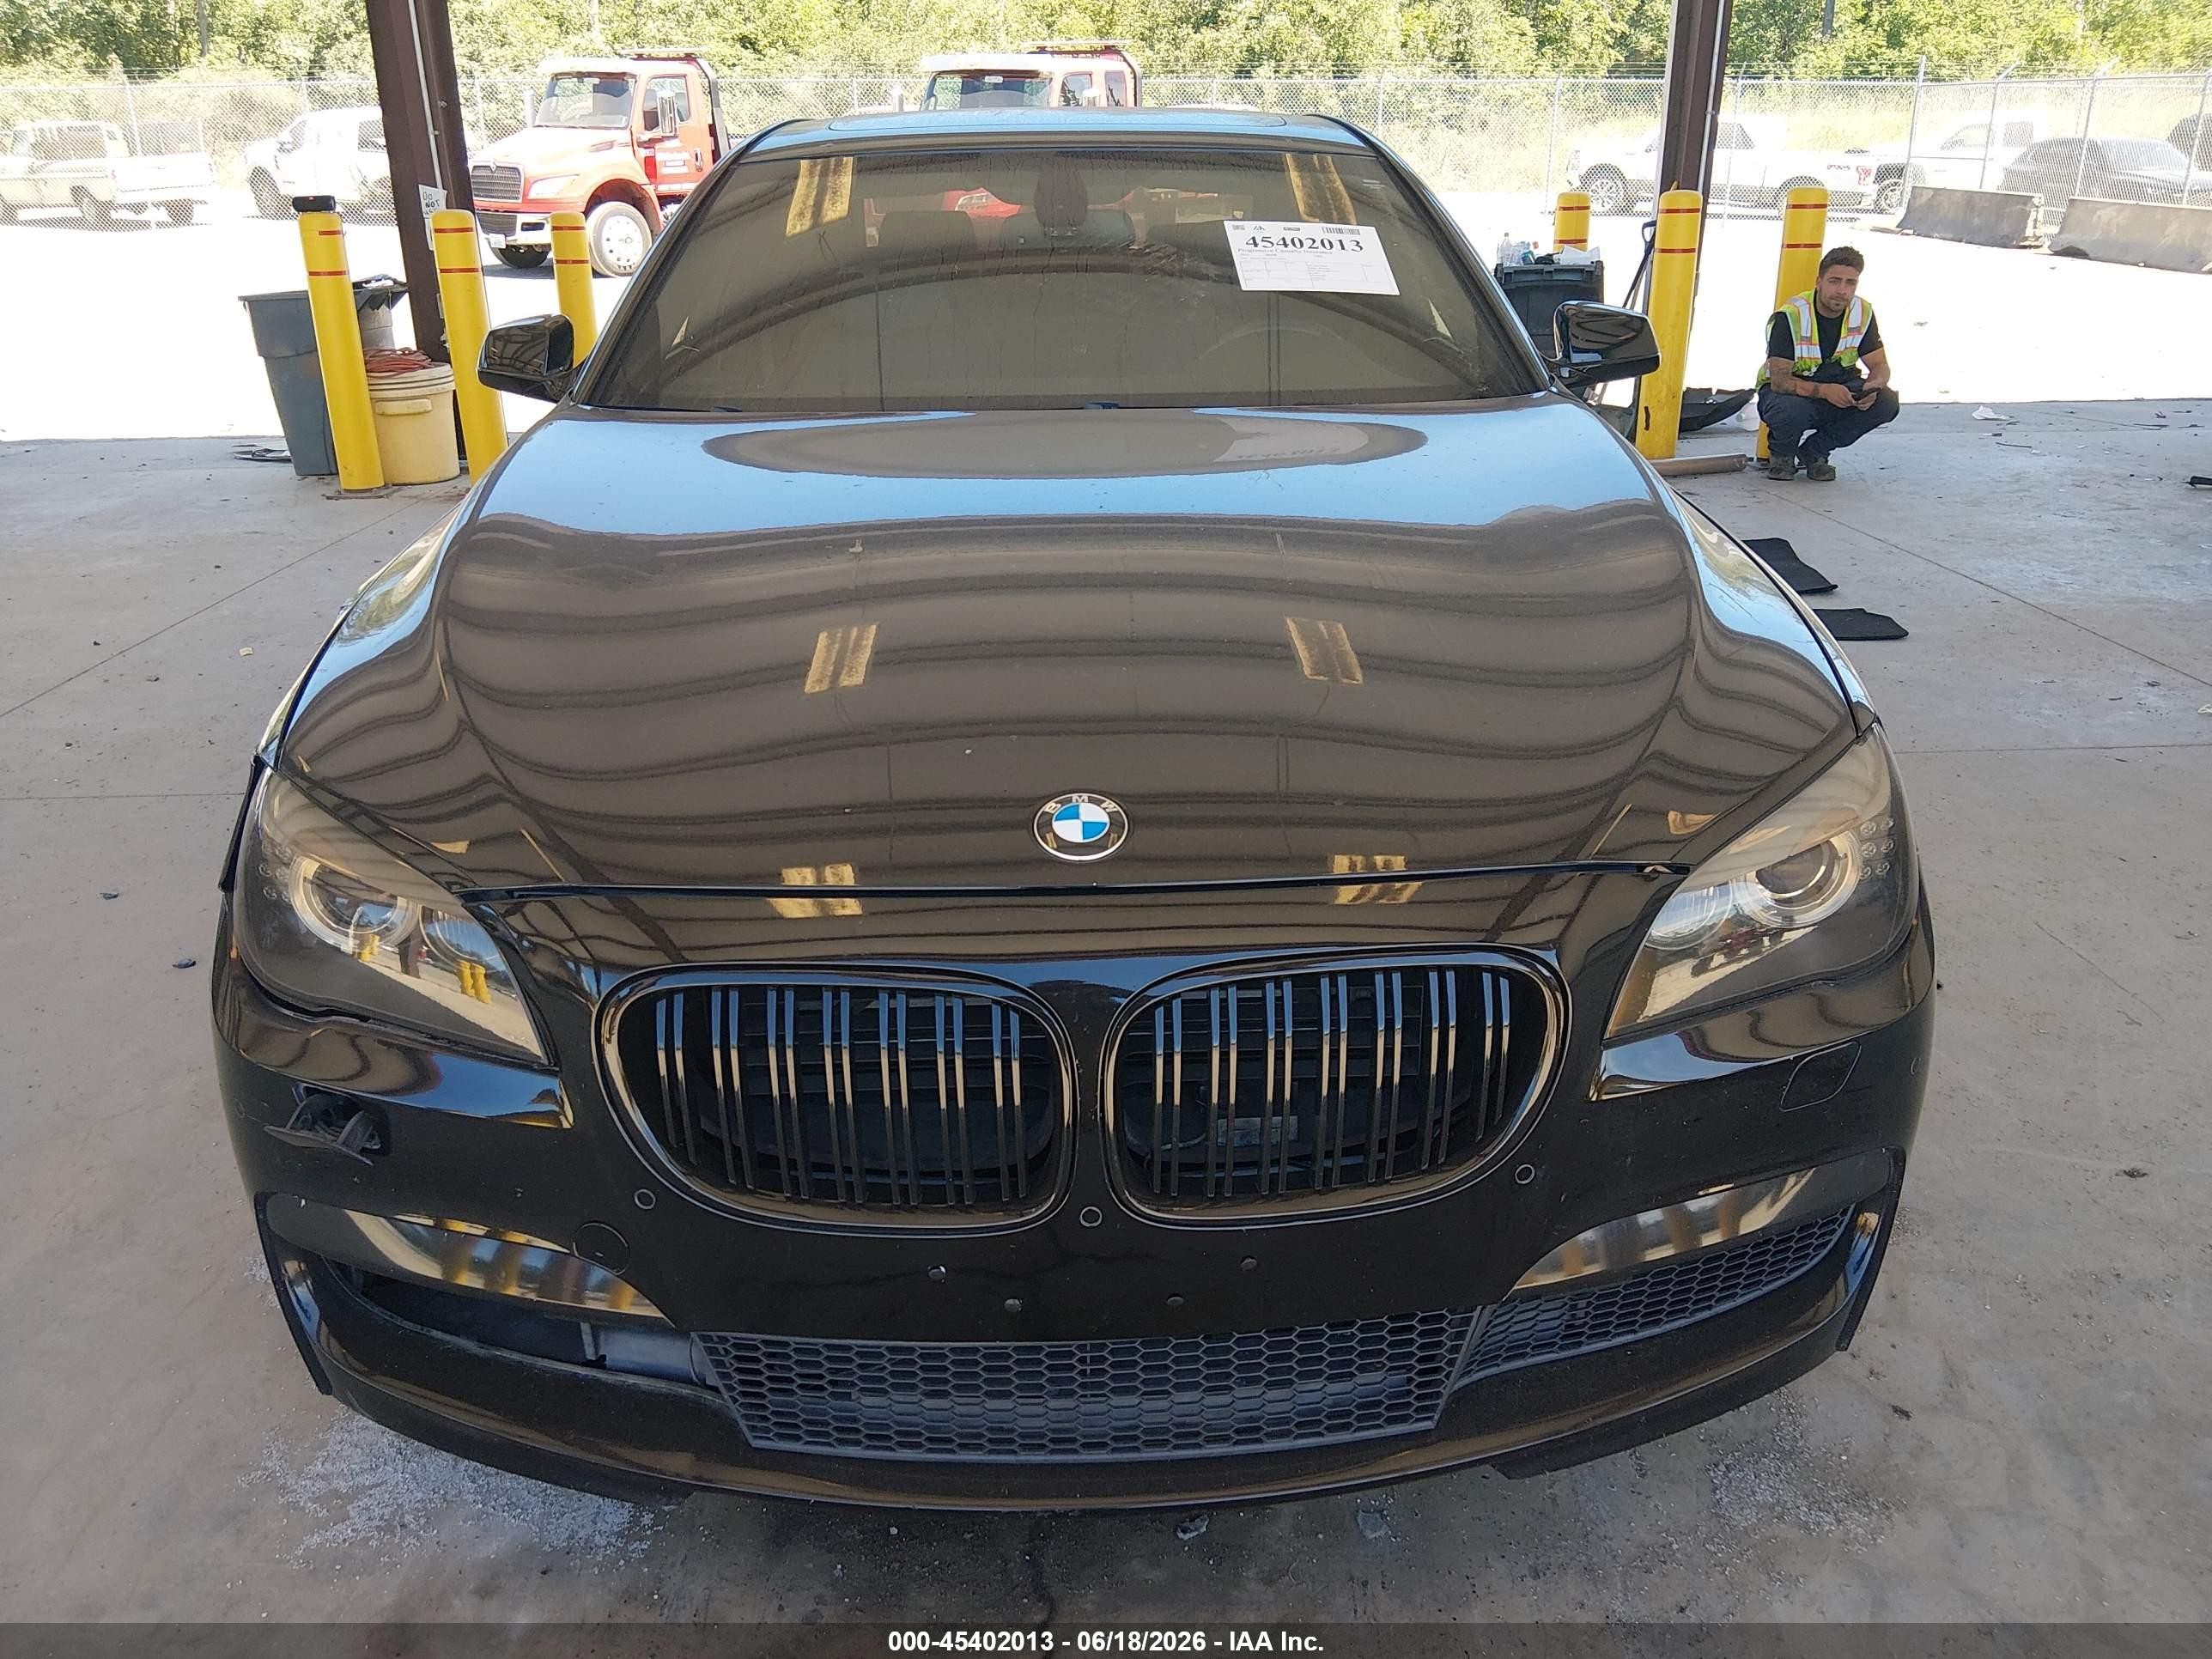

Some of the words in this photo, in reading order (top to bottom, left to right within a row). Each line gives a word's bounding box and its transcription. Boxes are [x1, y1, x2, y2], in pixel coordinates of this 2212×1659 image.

[425, 199, 440, 208] NOT
[1246, 236, 1364, 252] 45402013
[1043, 795, 1118, 813] BMW
